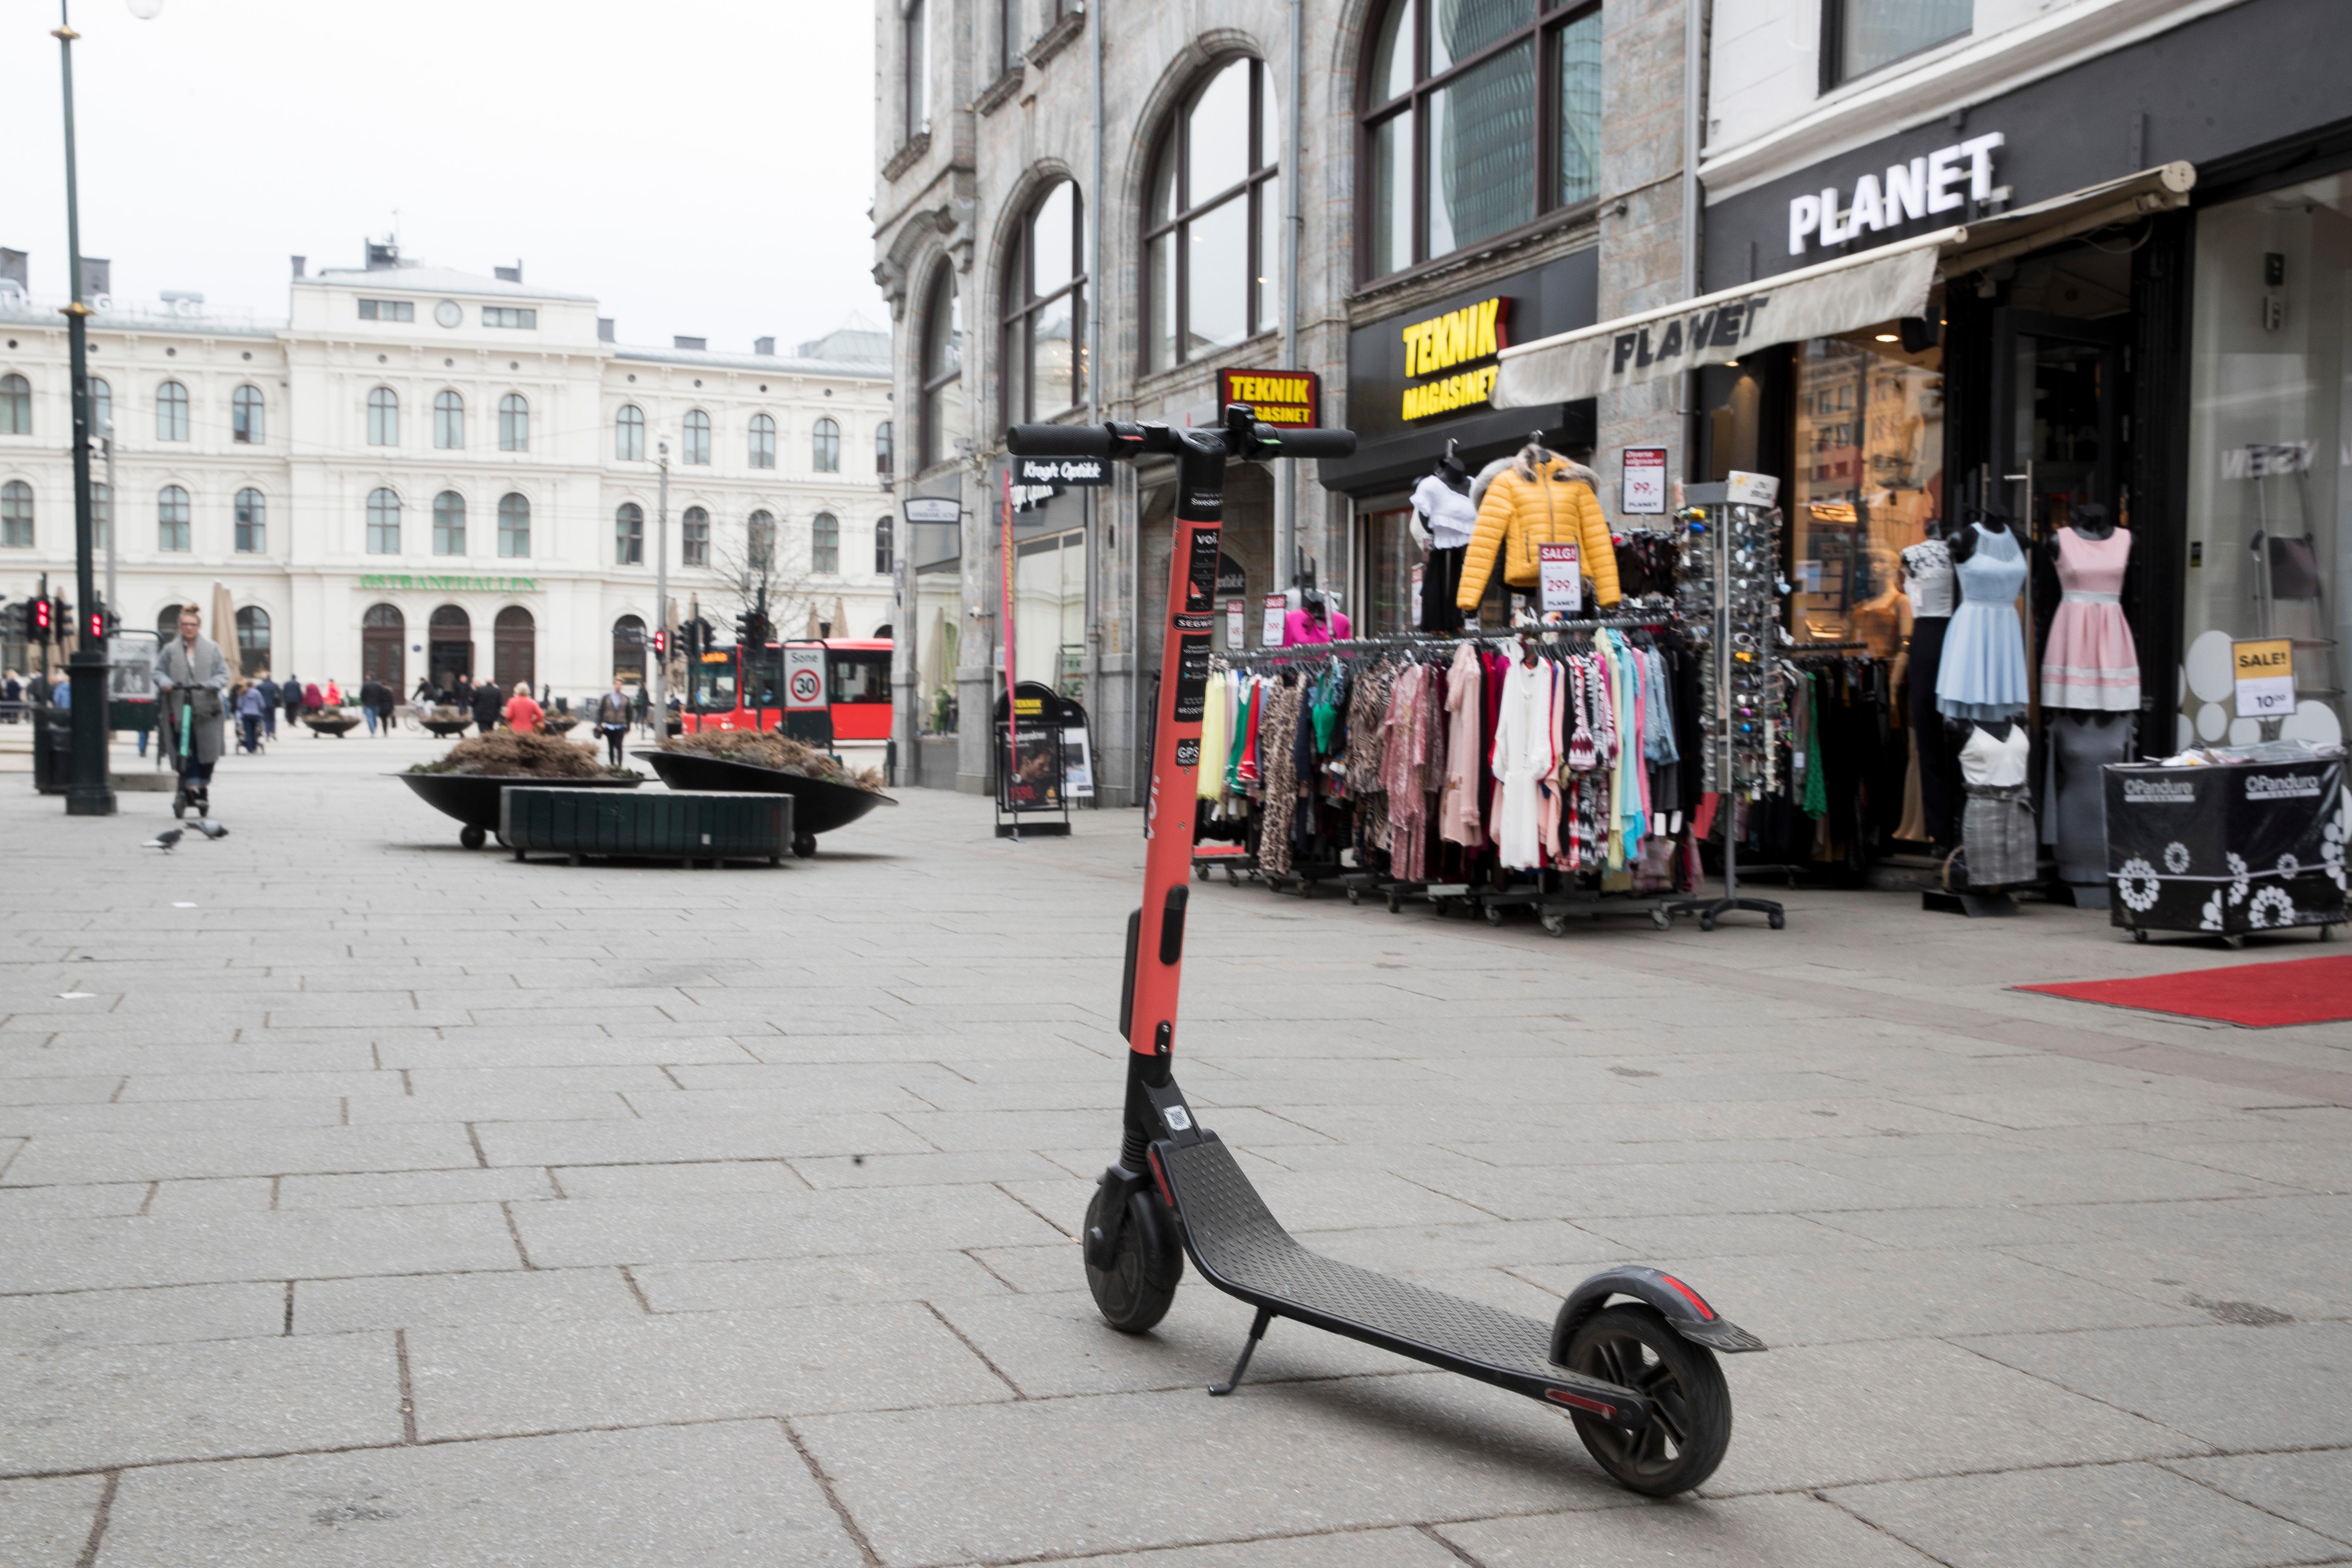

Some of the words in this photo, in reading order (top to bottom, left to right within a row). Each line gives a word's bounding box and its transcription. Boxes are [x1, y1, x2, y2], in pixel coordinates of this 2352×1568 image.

[1788, 132, 2004, 255] PLANET
[1403, 297, 1500, 378] TEKNIK
[1613, 297, 1770, 374] PLANET
[1229, 376, 1310, 404] TEKNIK
[1402, 364, 1498, 421] MAGASINET
[1254, 406, 1311, 423] GASINET
[1023, 461, 1059, 482] Krogh
[1060, 462, 1102, 481] Optikk
[1541, 548, 1576, 559] SALG!
[791, 652, 818, 663] Sone
[2239, 652, 2286, 668] SALE!
[796, 677, 815, 694] 30
[1178, 746, 1200, 759] GPS
